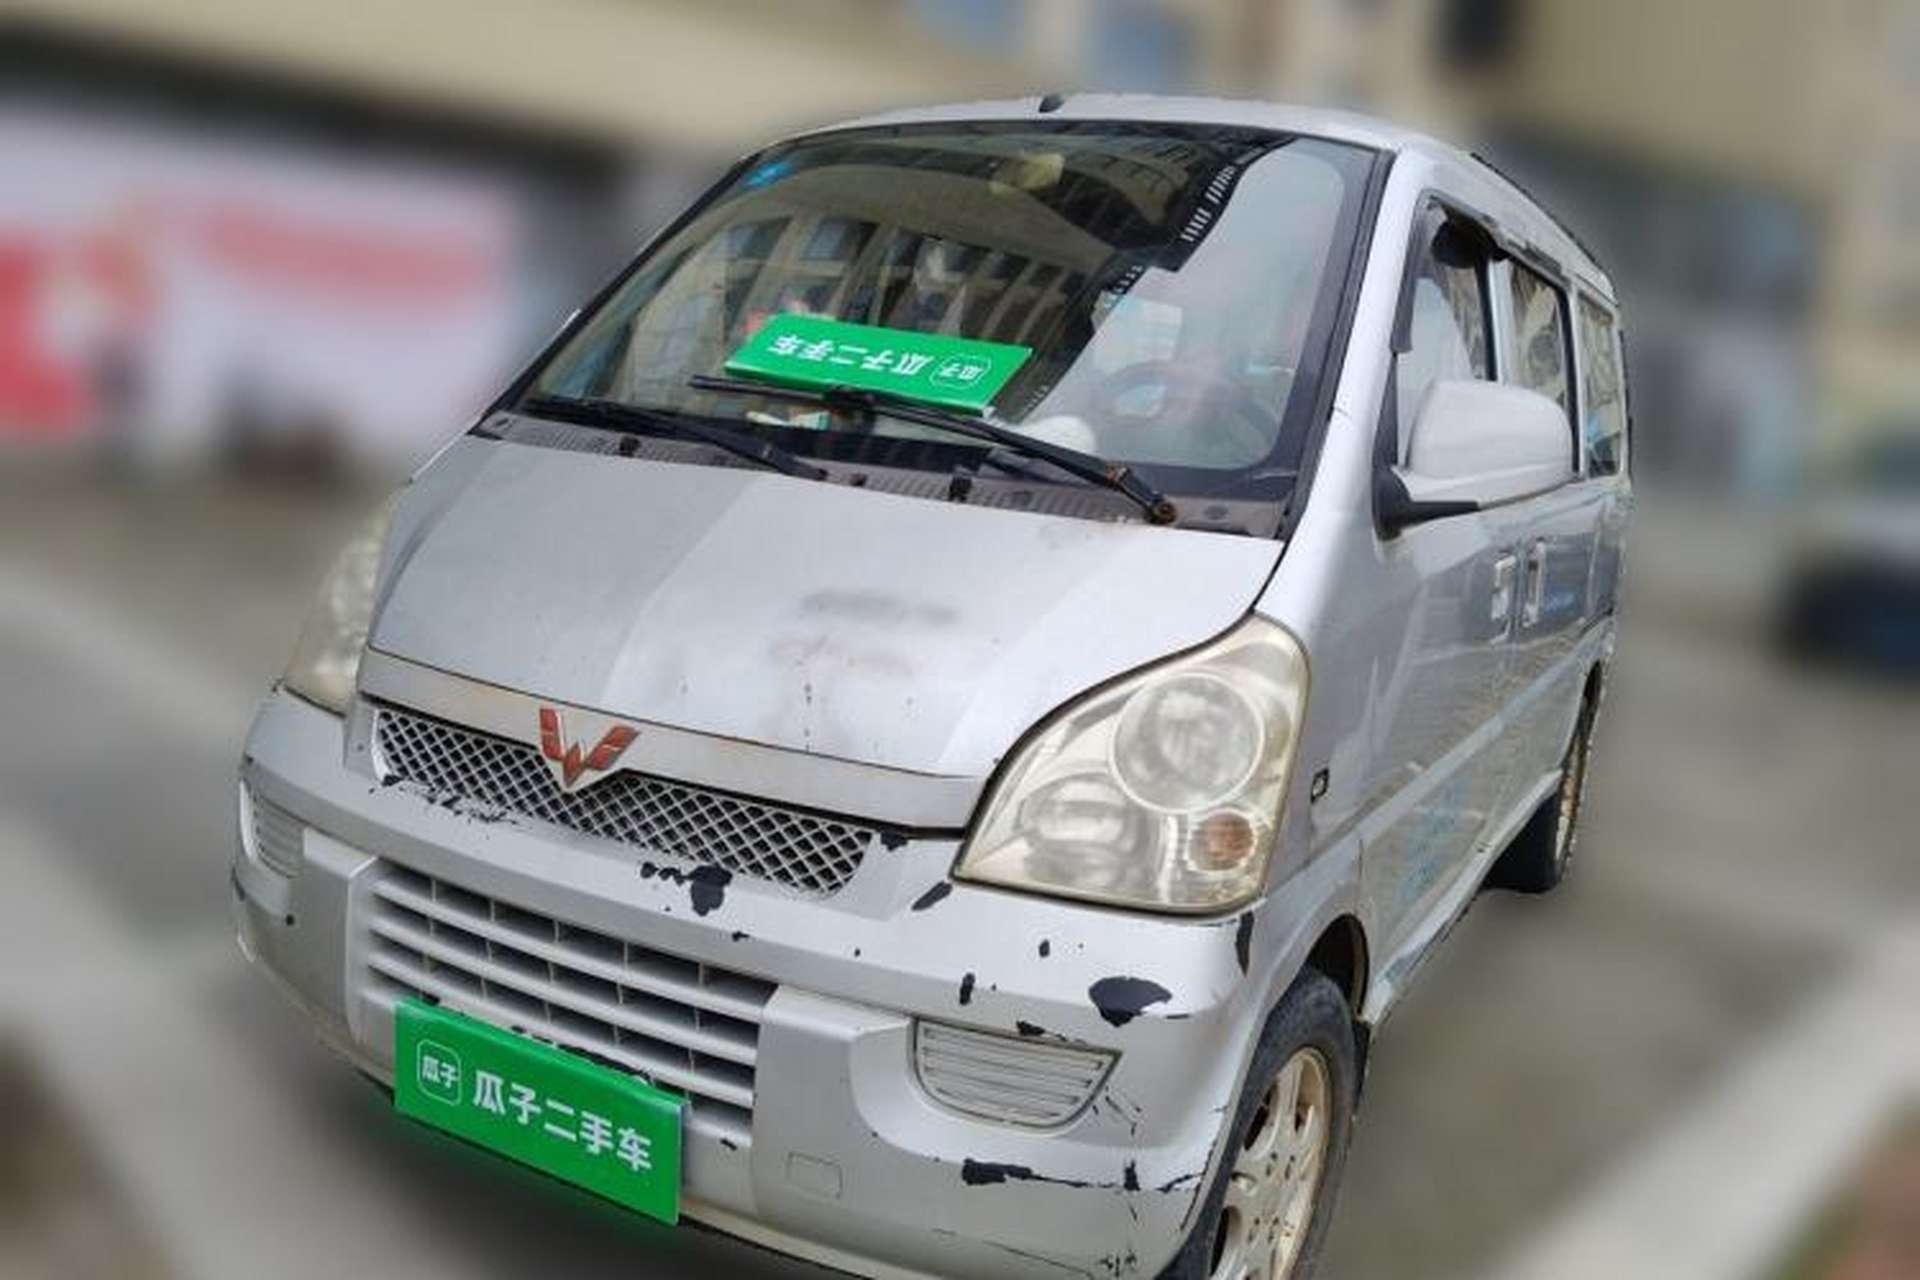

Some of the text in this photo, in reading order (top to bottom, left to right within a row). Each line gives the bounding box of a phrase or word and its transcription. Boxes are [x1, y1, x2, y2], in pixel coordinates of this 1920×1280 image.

[769, 333, 934, 376] 瓜子二手车
[939, 361, 984, 381] 瓜子
[421, 1055, 459, 1089] 瓜子
[473, 1069, 652, 1172] 瓜子二手车
